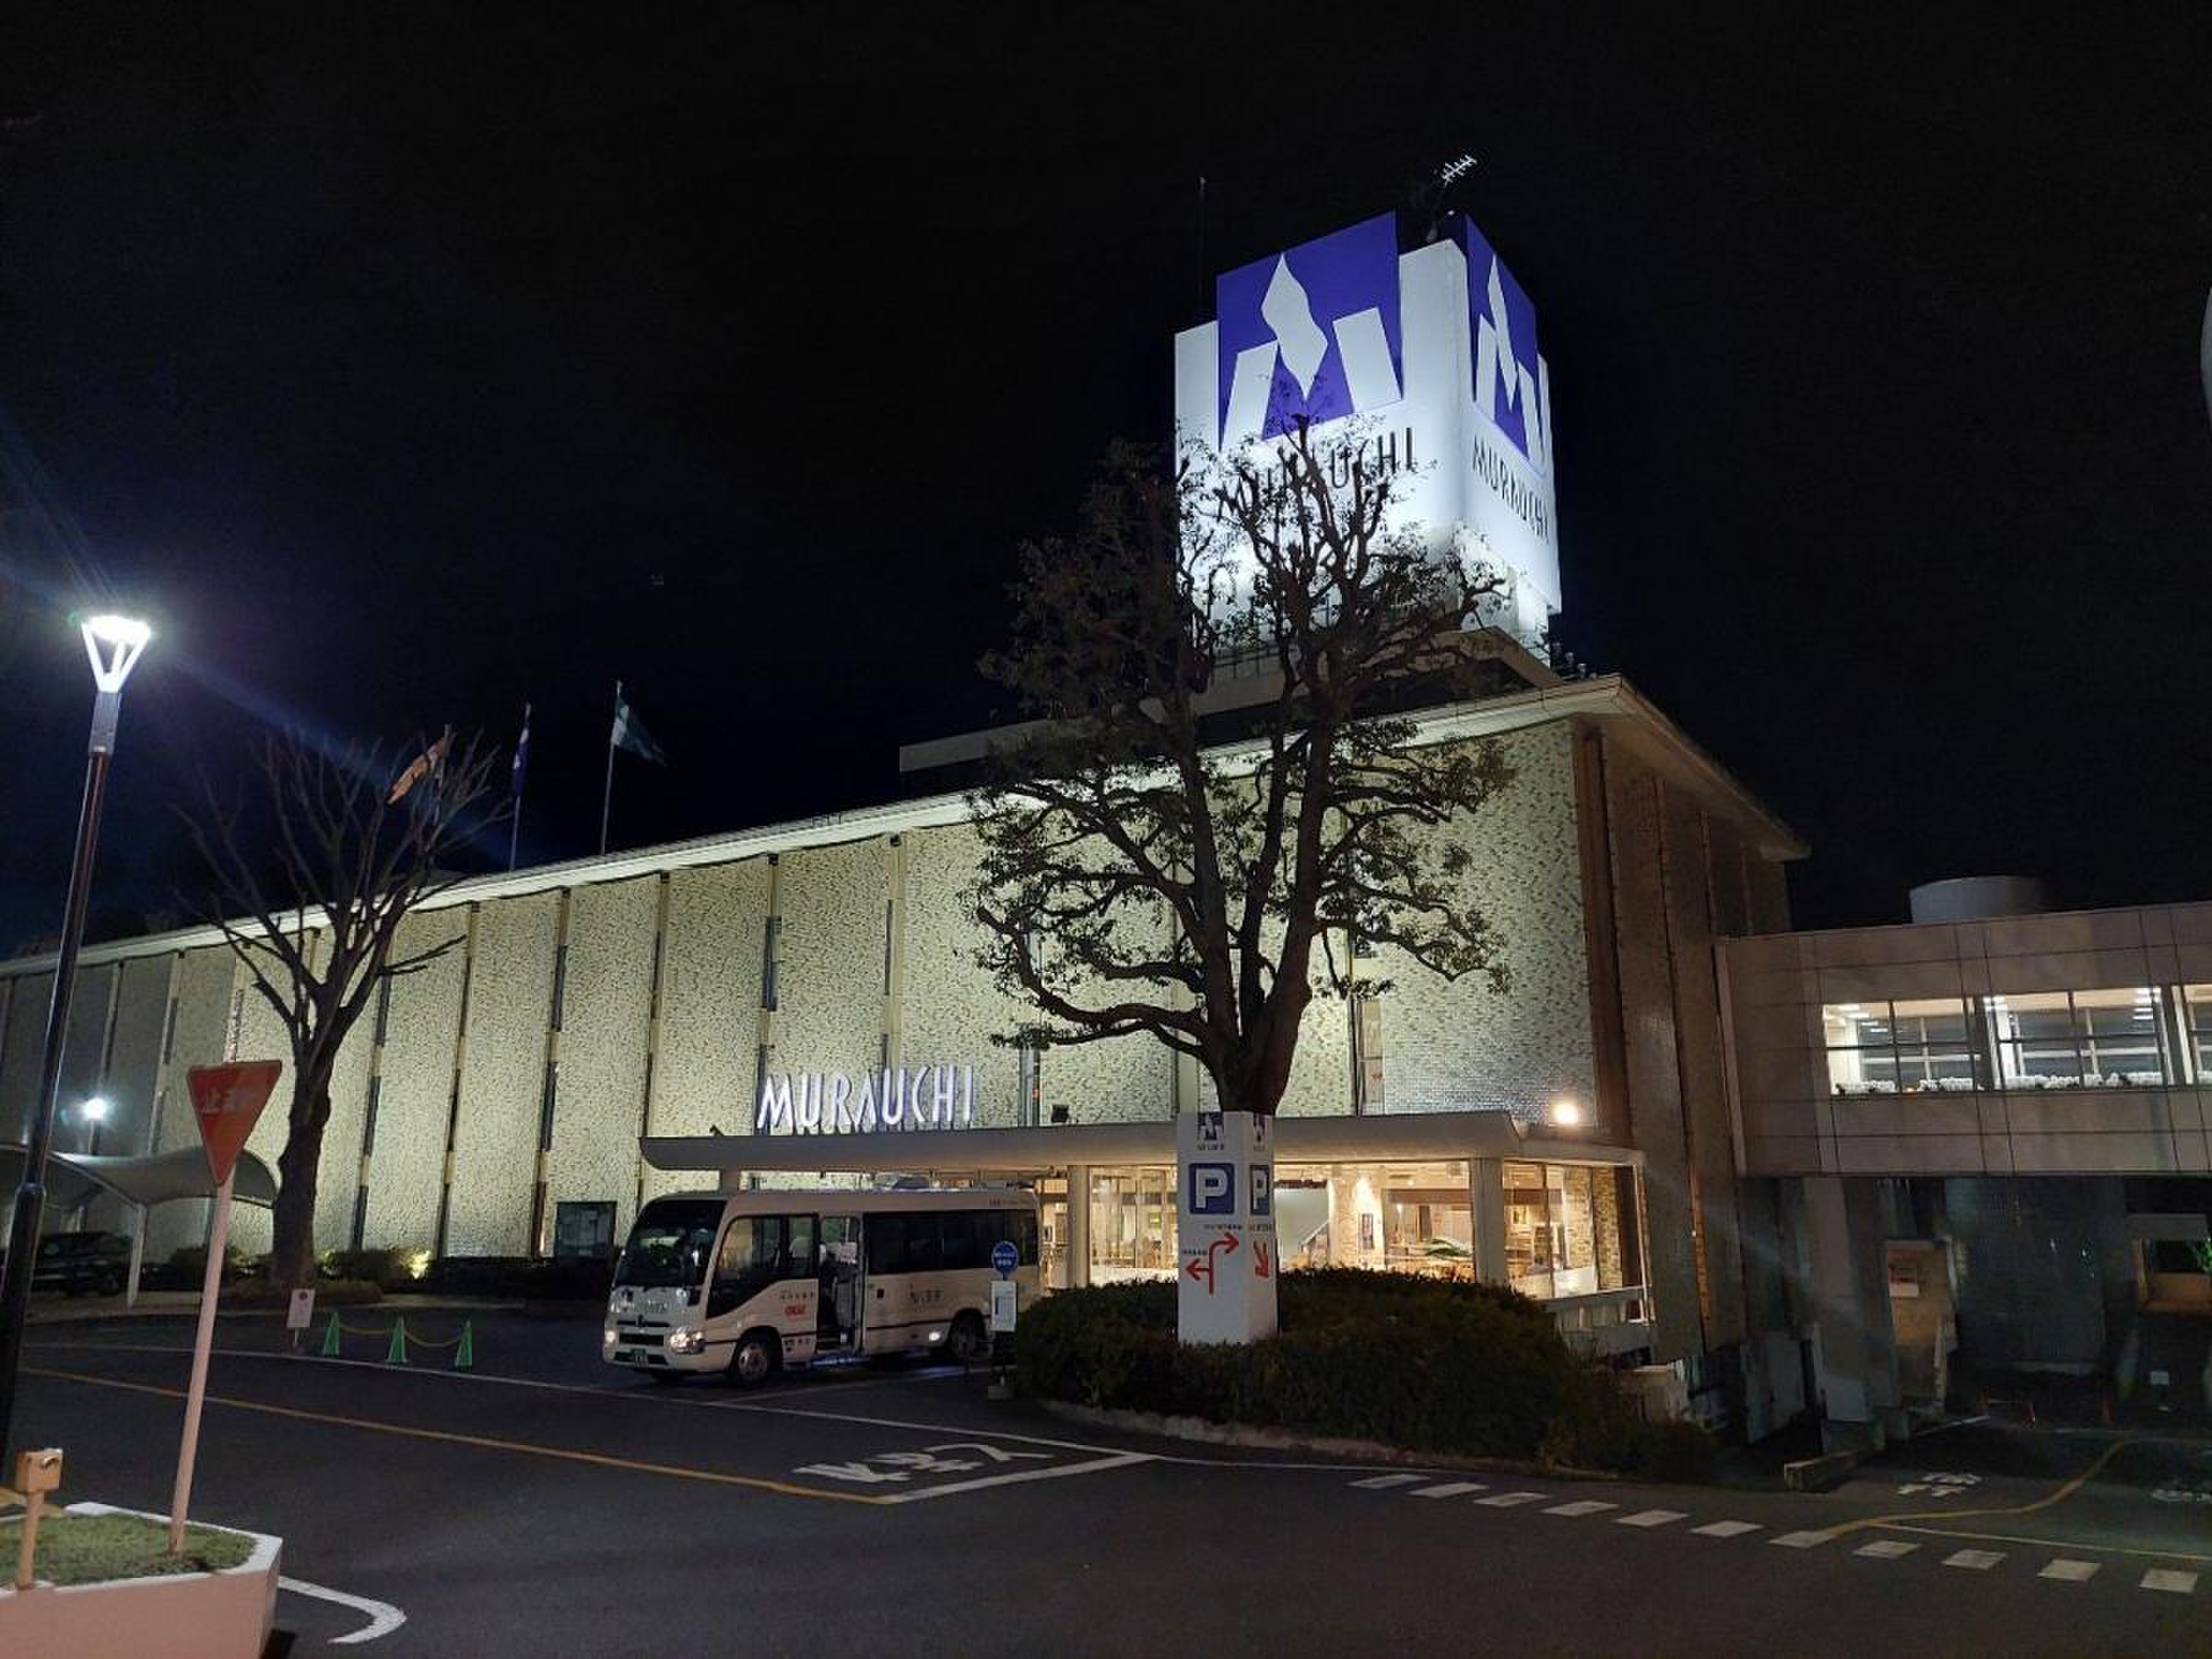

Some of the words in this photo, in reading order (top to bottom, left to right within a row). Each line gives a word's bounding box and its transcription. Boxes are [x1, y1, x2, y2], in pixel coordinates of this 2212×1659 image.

[1472, 435, 1549, 544] MURAUCHI
[757, 1063, 974, 1132] MURAUCHI
[1194, 1168, 1229, 1209] P
[1253, 1169, 1267, 1210] P
